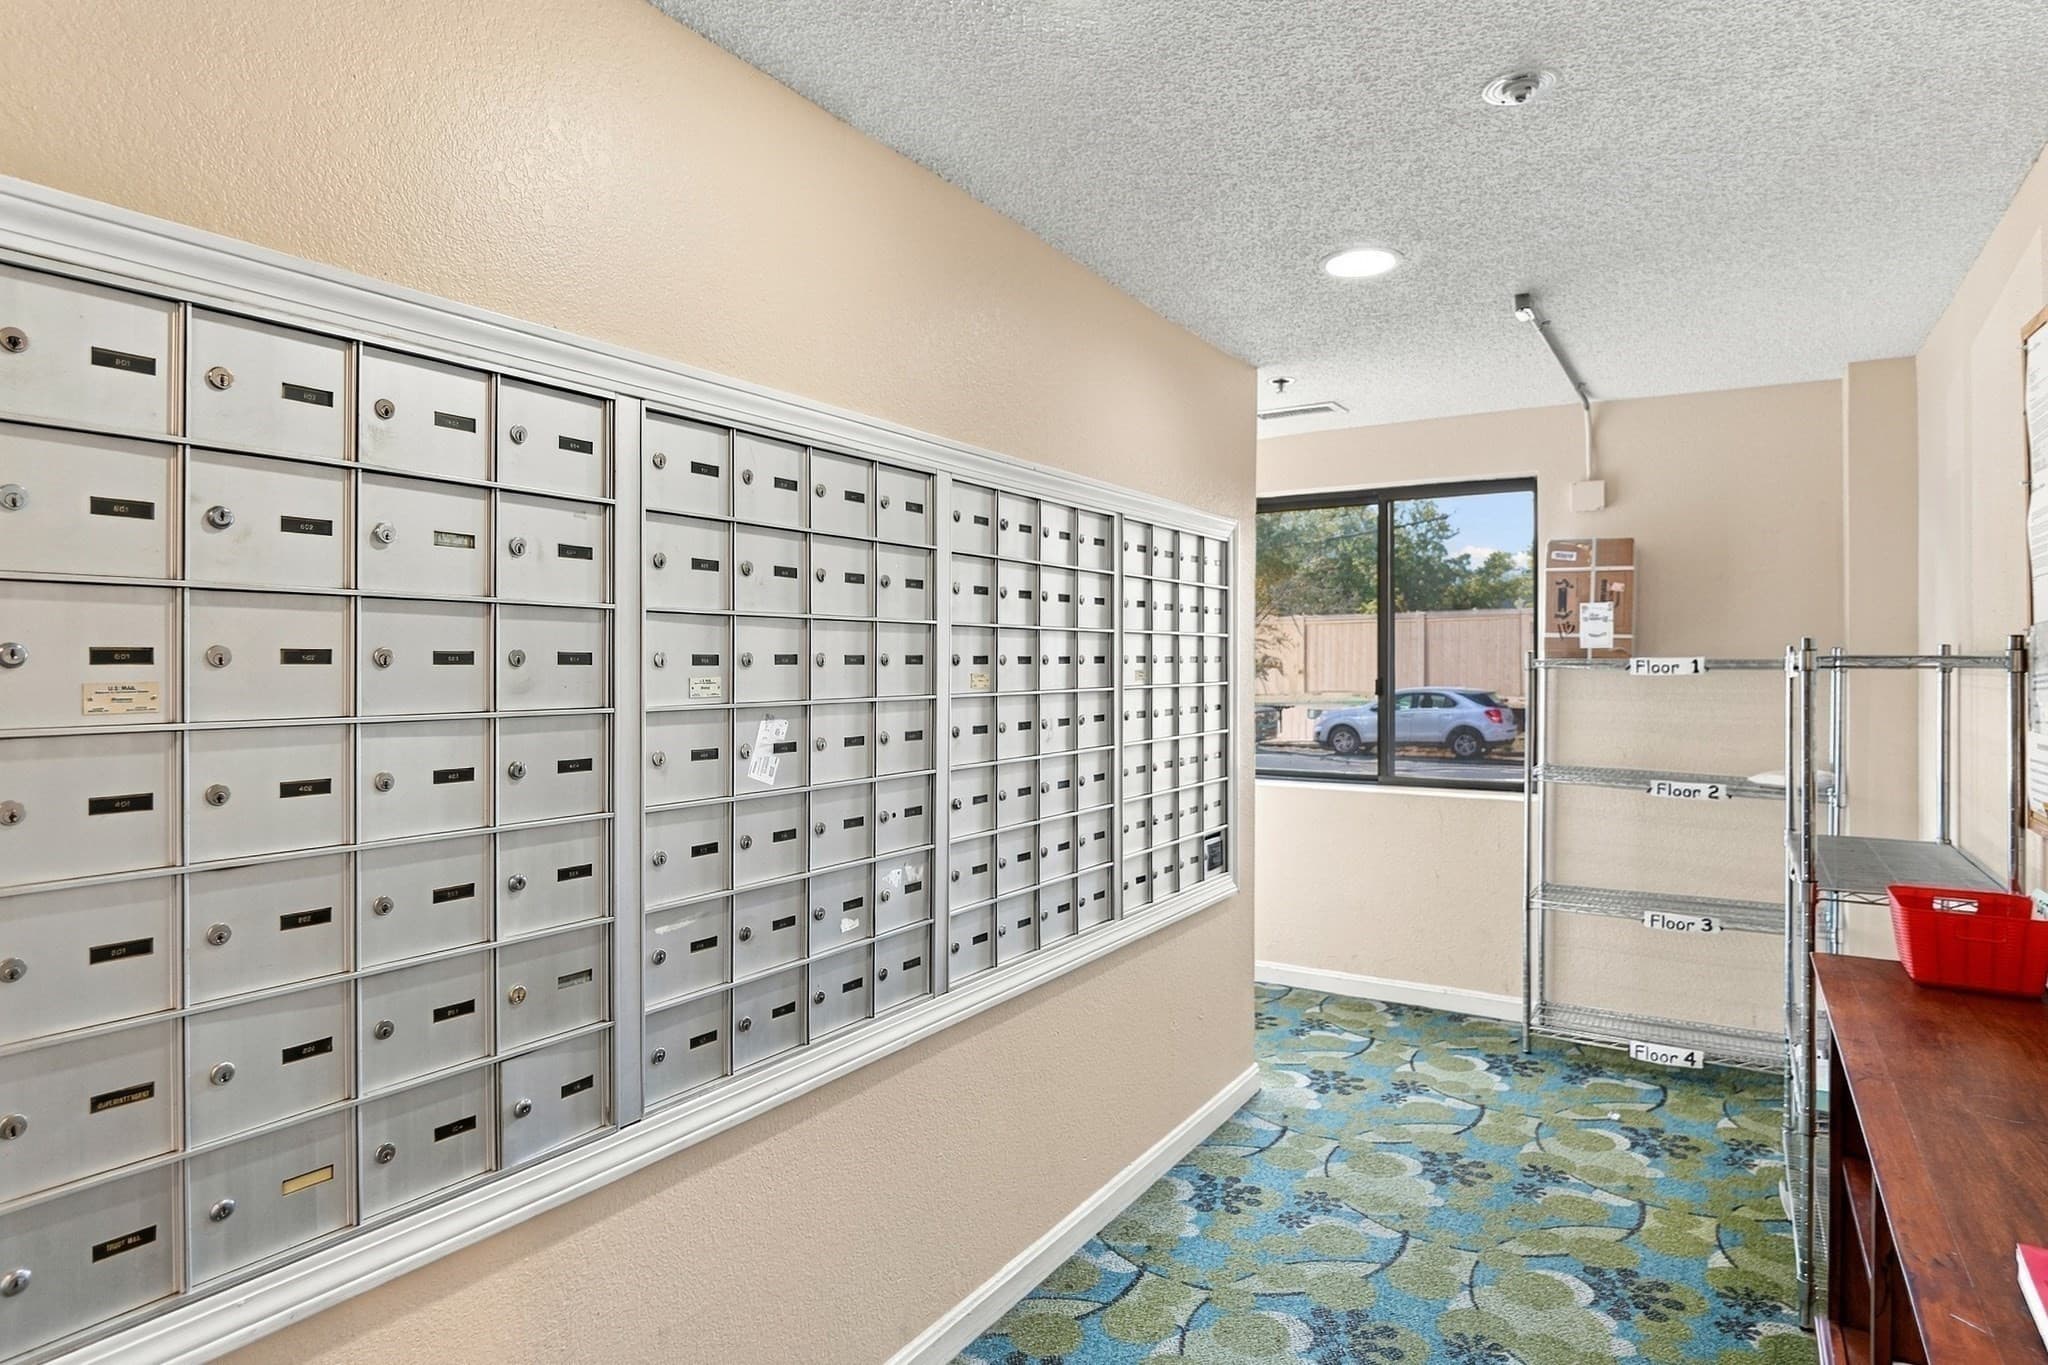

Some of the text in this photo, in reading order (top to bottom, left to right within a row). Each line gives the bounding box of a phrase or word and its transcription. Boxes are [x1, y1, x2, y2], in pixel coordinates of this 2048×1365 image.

[1635, 659, 1699, 673] Floor 1
[1657, 783, 1719, 799] Floor 2
[1650, 914, 1713, 932] Floor 3
[1635, 1044, 1697, 1066] Floor 4
